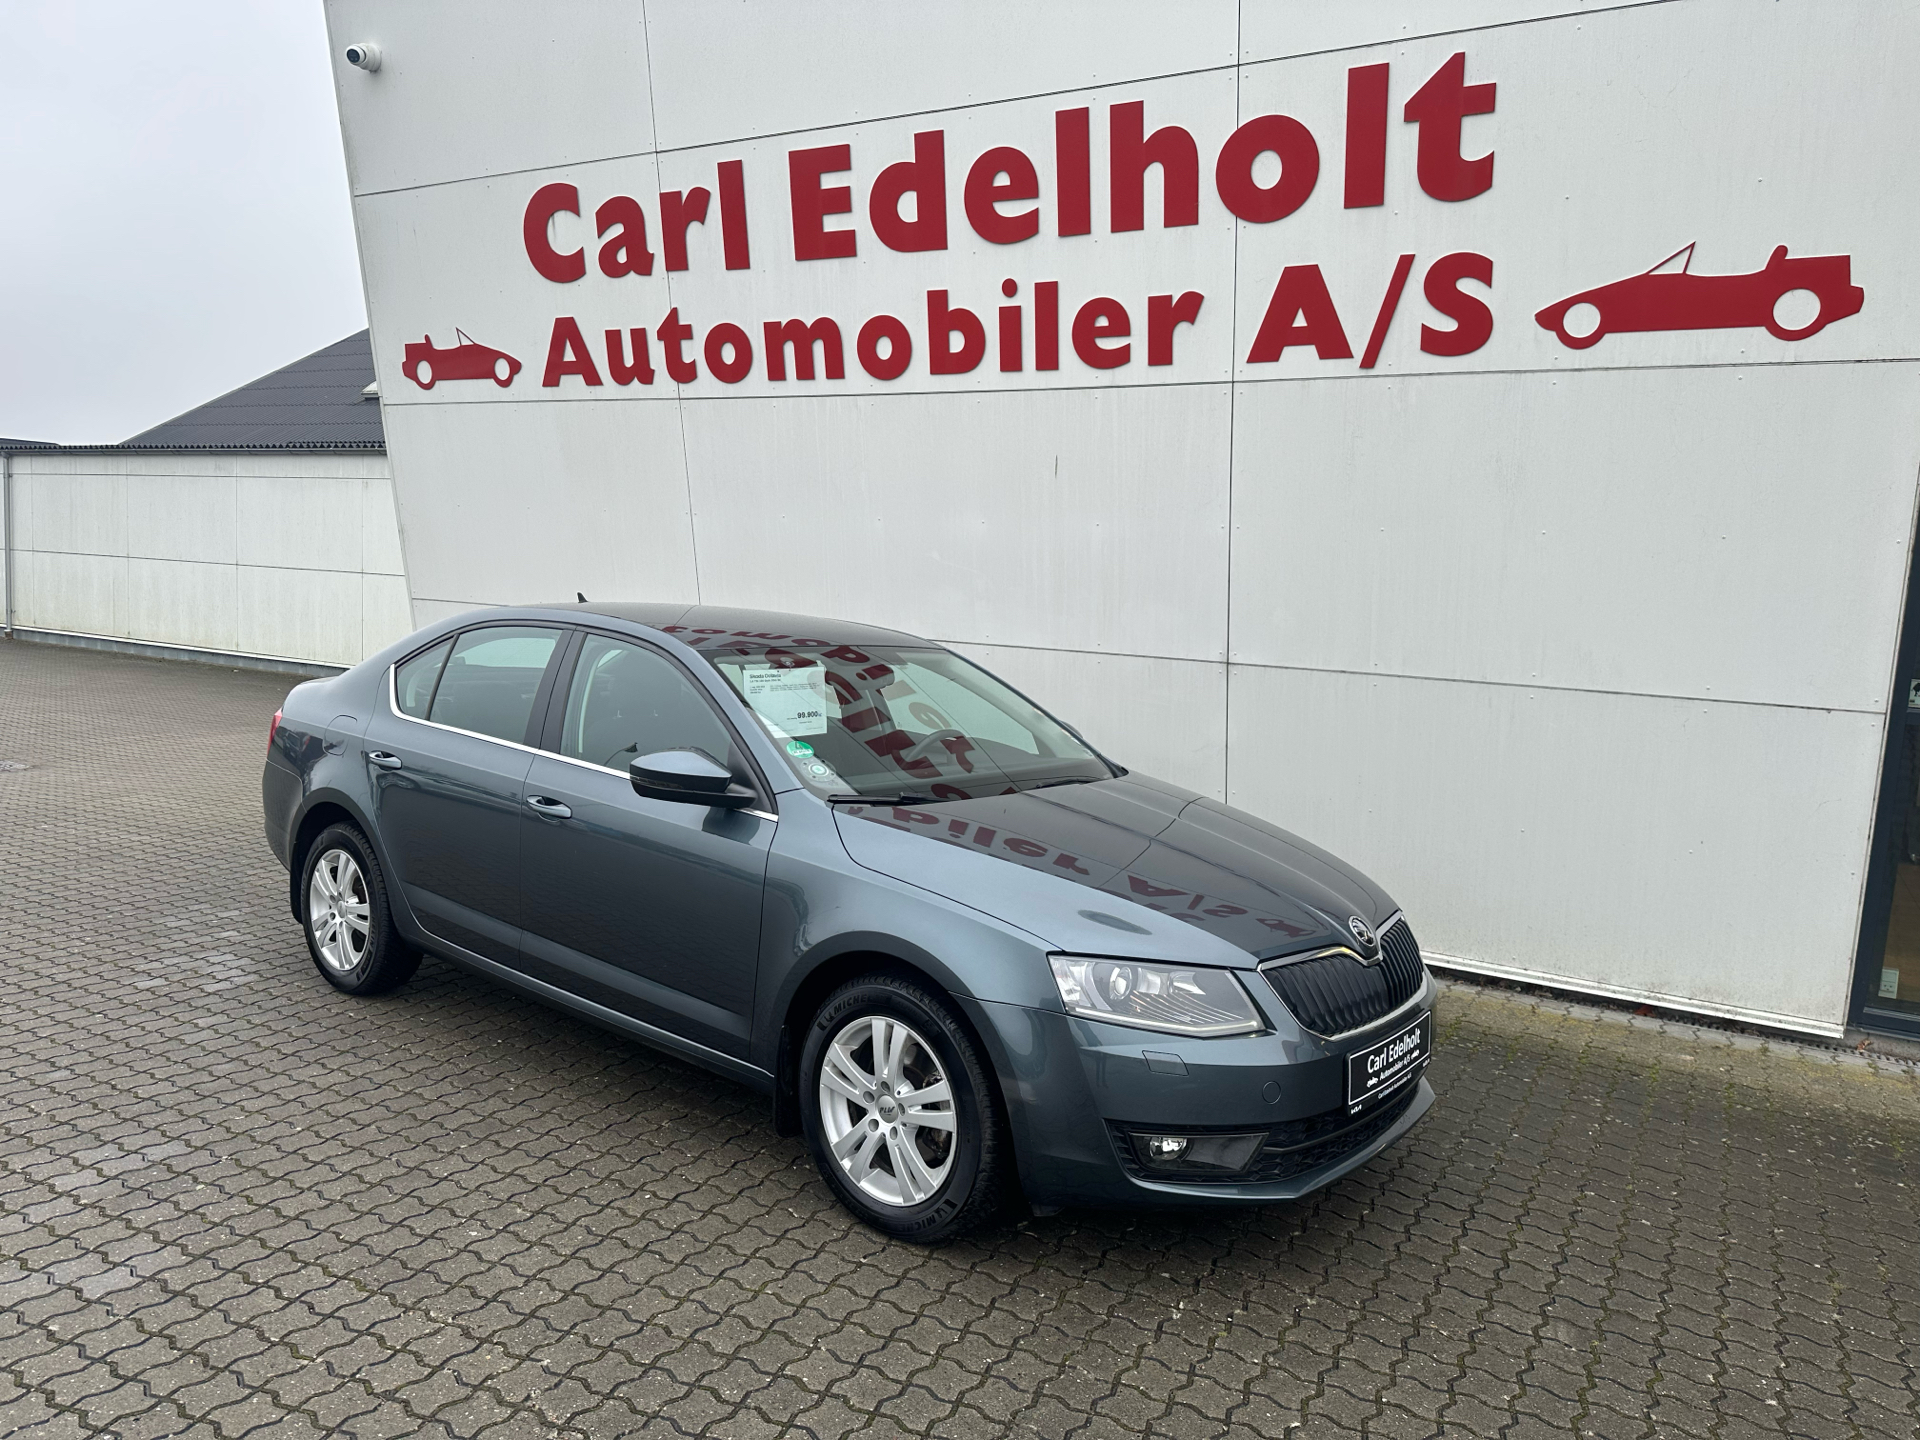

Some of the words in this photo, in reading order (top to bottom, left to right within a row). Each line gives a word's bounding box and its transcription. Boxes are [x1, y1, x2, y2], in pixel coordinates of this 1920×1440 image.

[523, 159, 750, 284] Carl
[788, 51, 1498, 262] Edelholt
[542, 278, 1204, 388] Automobiler
[1246, 252, 1494, 370] A/S
[1367, 1047, 1387, 1074] Carl
[1388, 1027, 1421, 1063] Edelholt
